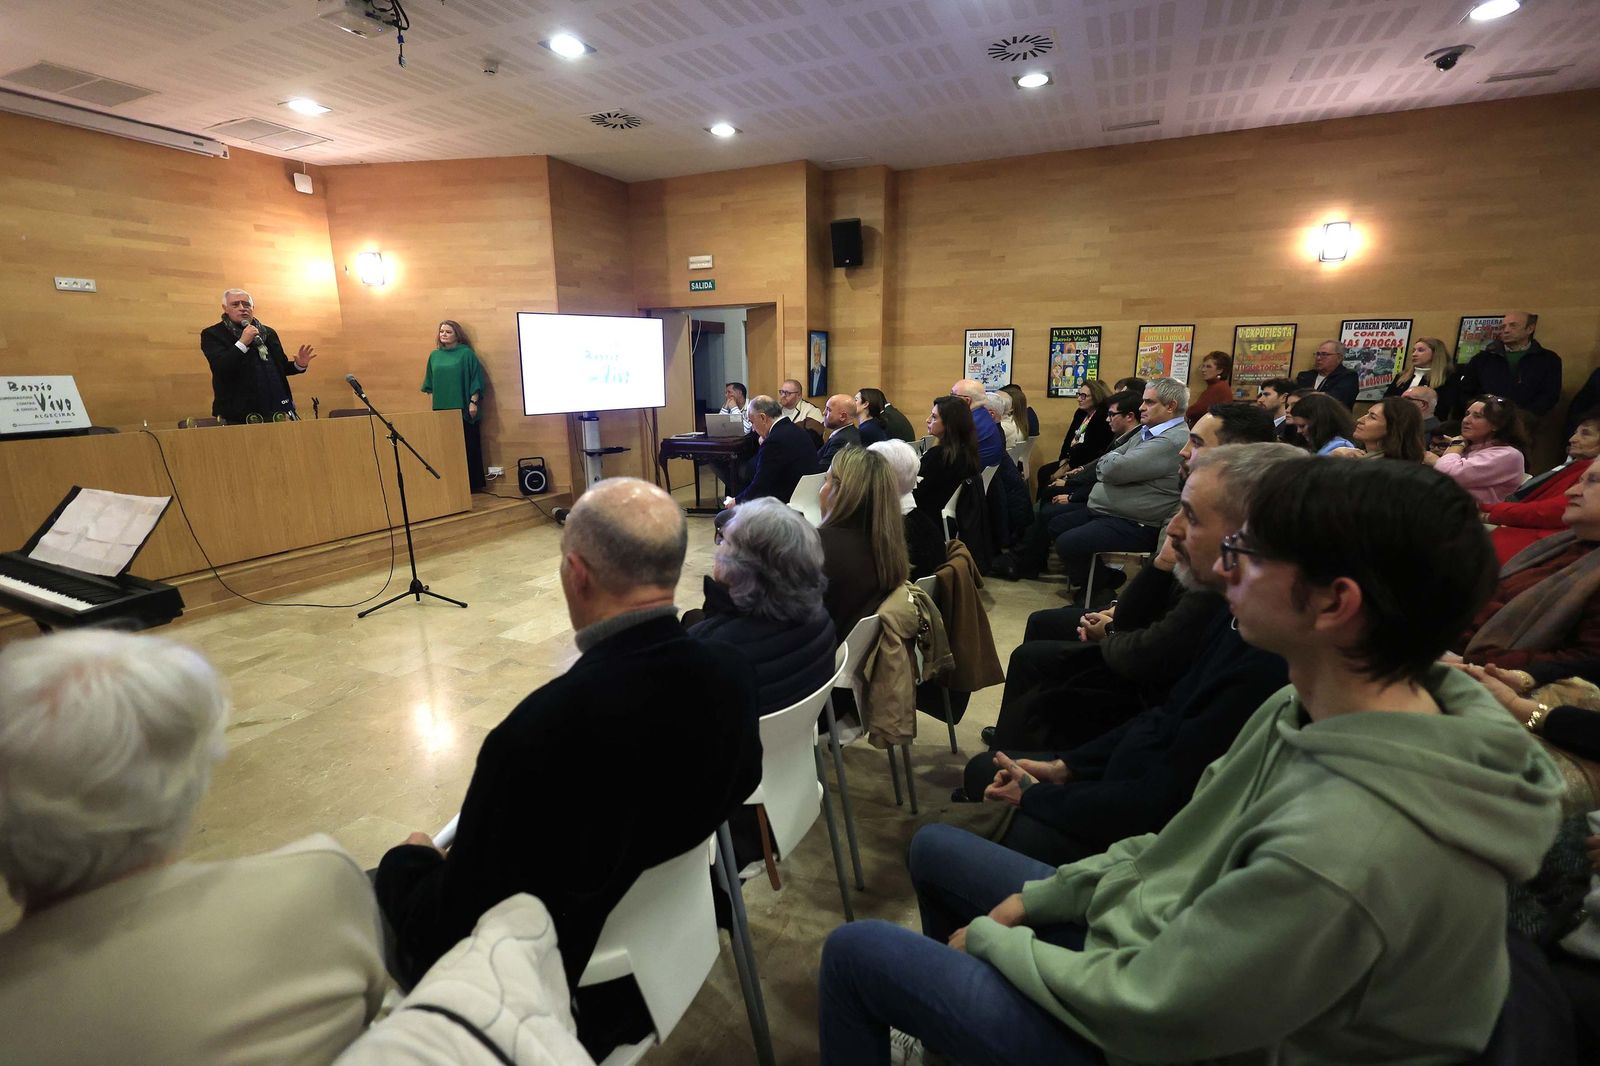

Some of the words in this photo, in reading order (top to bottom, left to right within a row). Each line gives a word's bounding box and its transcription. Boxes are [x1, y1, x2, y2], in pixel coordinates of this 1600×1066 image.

[691, 281, 713, 290] SALIDA
[1354, 322, 1380, 330] CARRERA
[1381, 321, 1408, 330] POPULAR
[1061, 328, 1099, 336] EXPOSICION
[1246, 326, 1292, 338] EXPOFIESTA
[989, 338, 1010, 347] DROGA
[1250, 343, 1276, 351] 2001
[1343, 339, 1360, 347] LAS
[1363, 338, 1404, 348] DROGAS
[1175, 342, 1190, 353] 24
[7, 381, 52, 392] Barrio
[34, 392, 72, 412] Vivo
